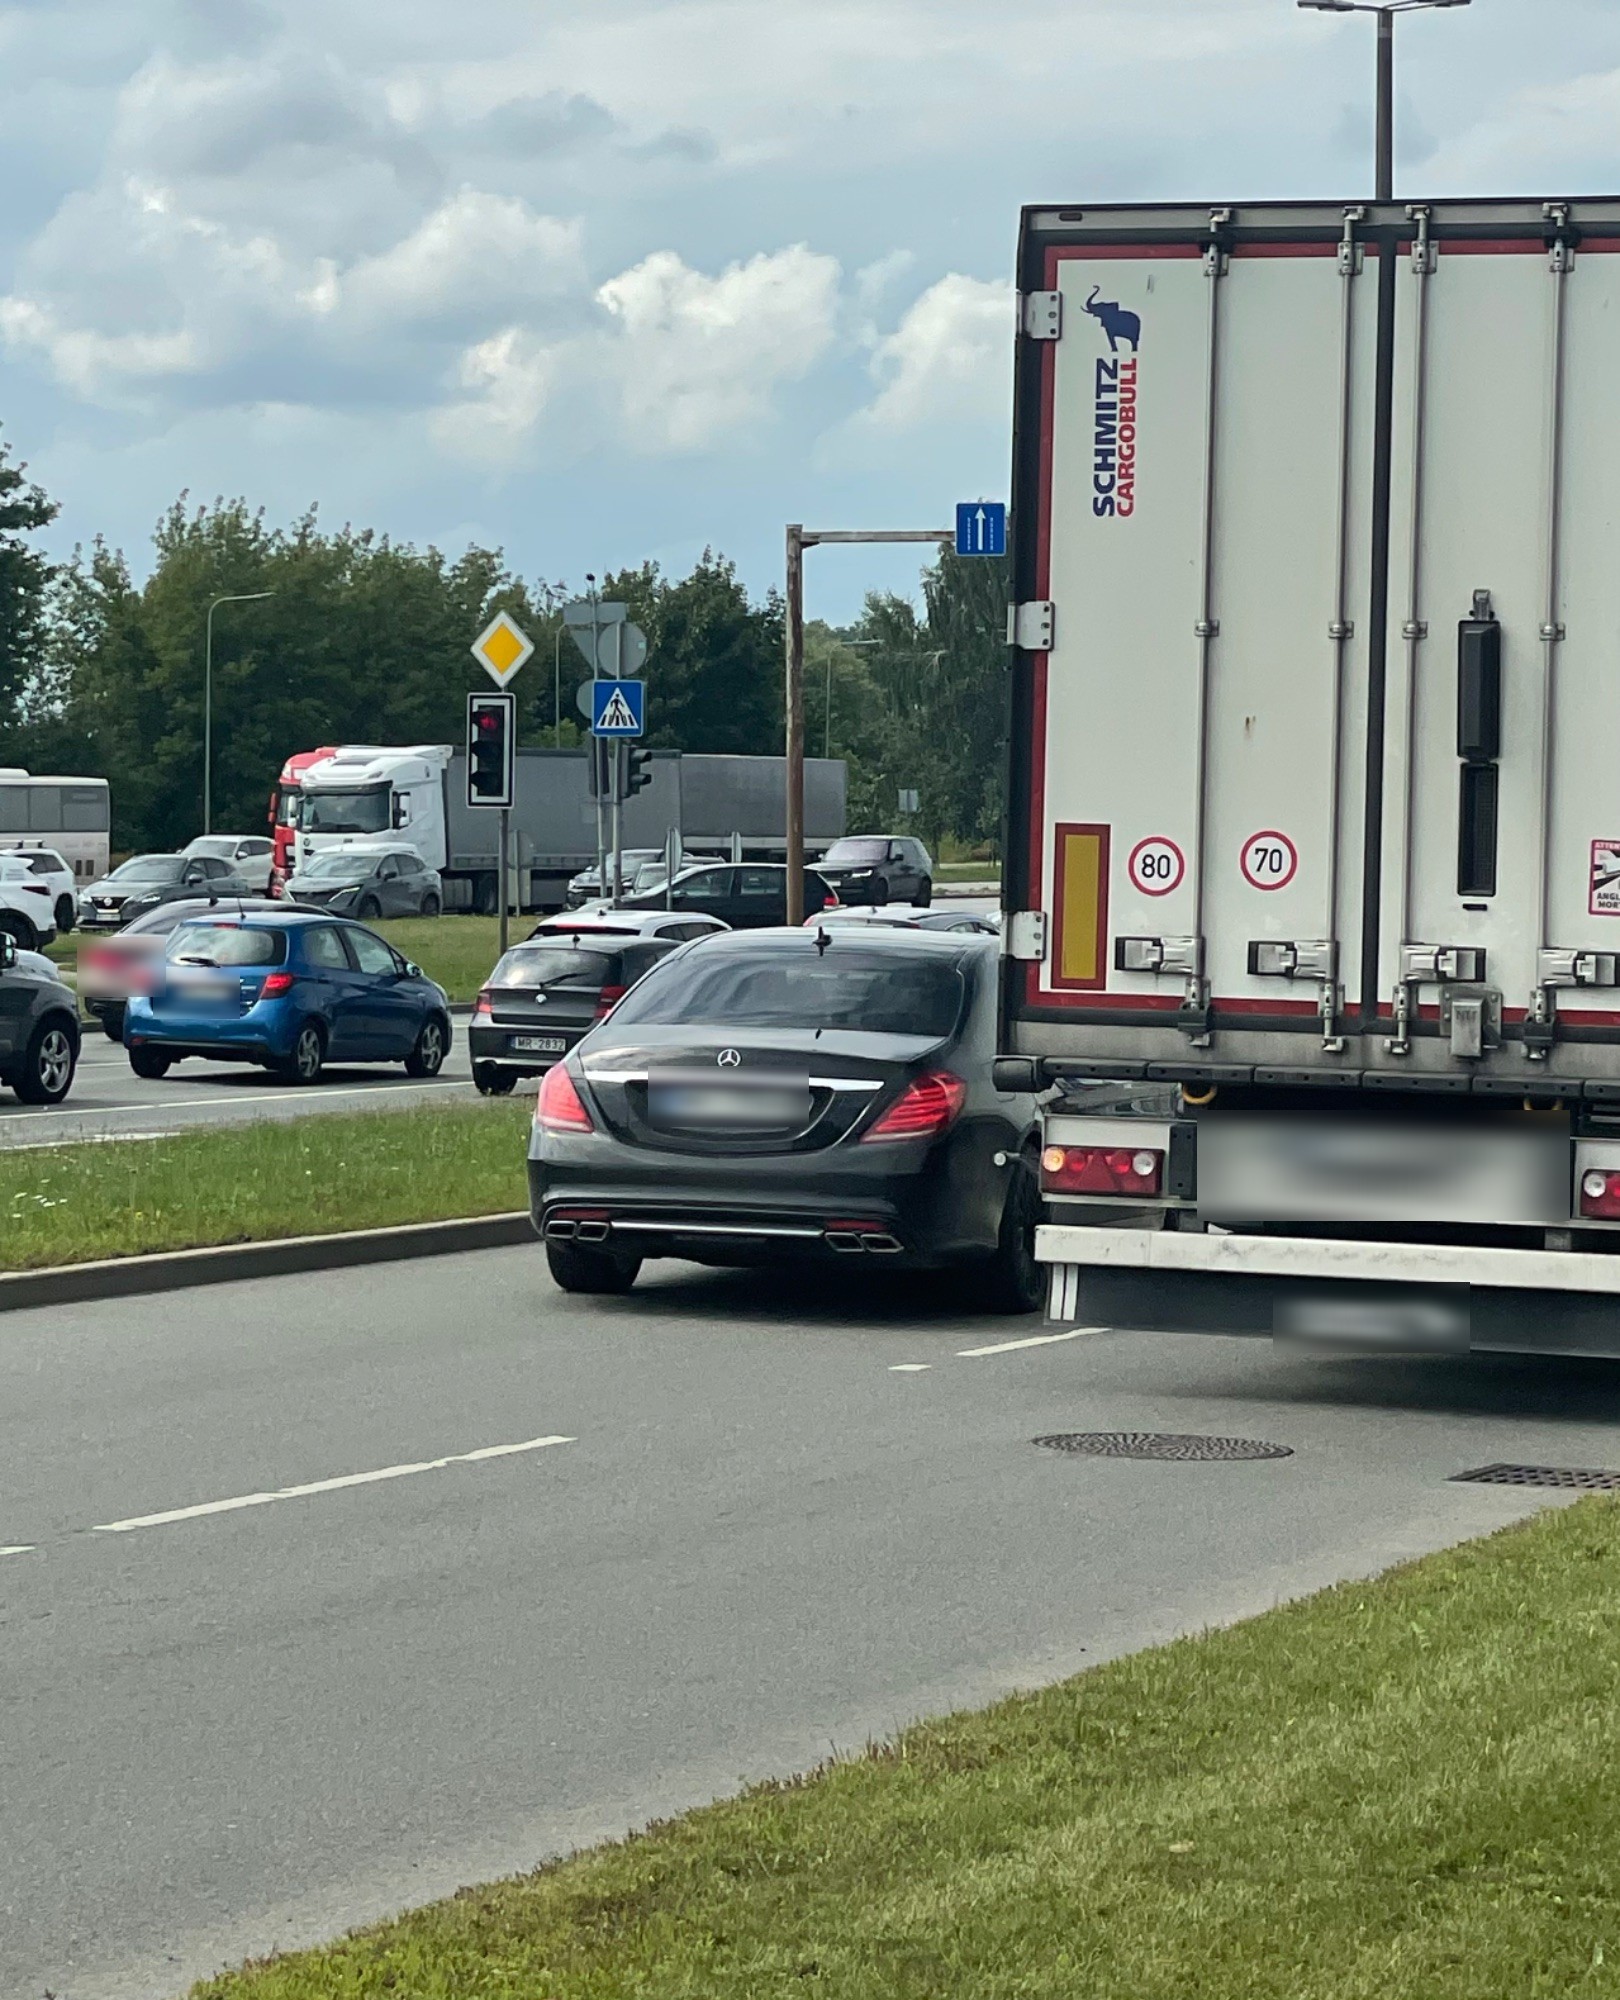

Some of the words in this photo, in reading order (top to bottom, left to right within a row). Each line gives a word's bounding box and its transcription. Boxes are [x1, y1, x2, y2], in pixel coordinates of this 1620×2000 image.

[1093, 358, 1118, 517] SCHMITZ
[1117, 358, 1137, 517] CARGOBULL
[1141, 854, 1170, 879] 80
[1254, 848, 1283, 873] 70
